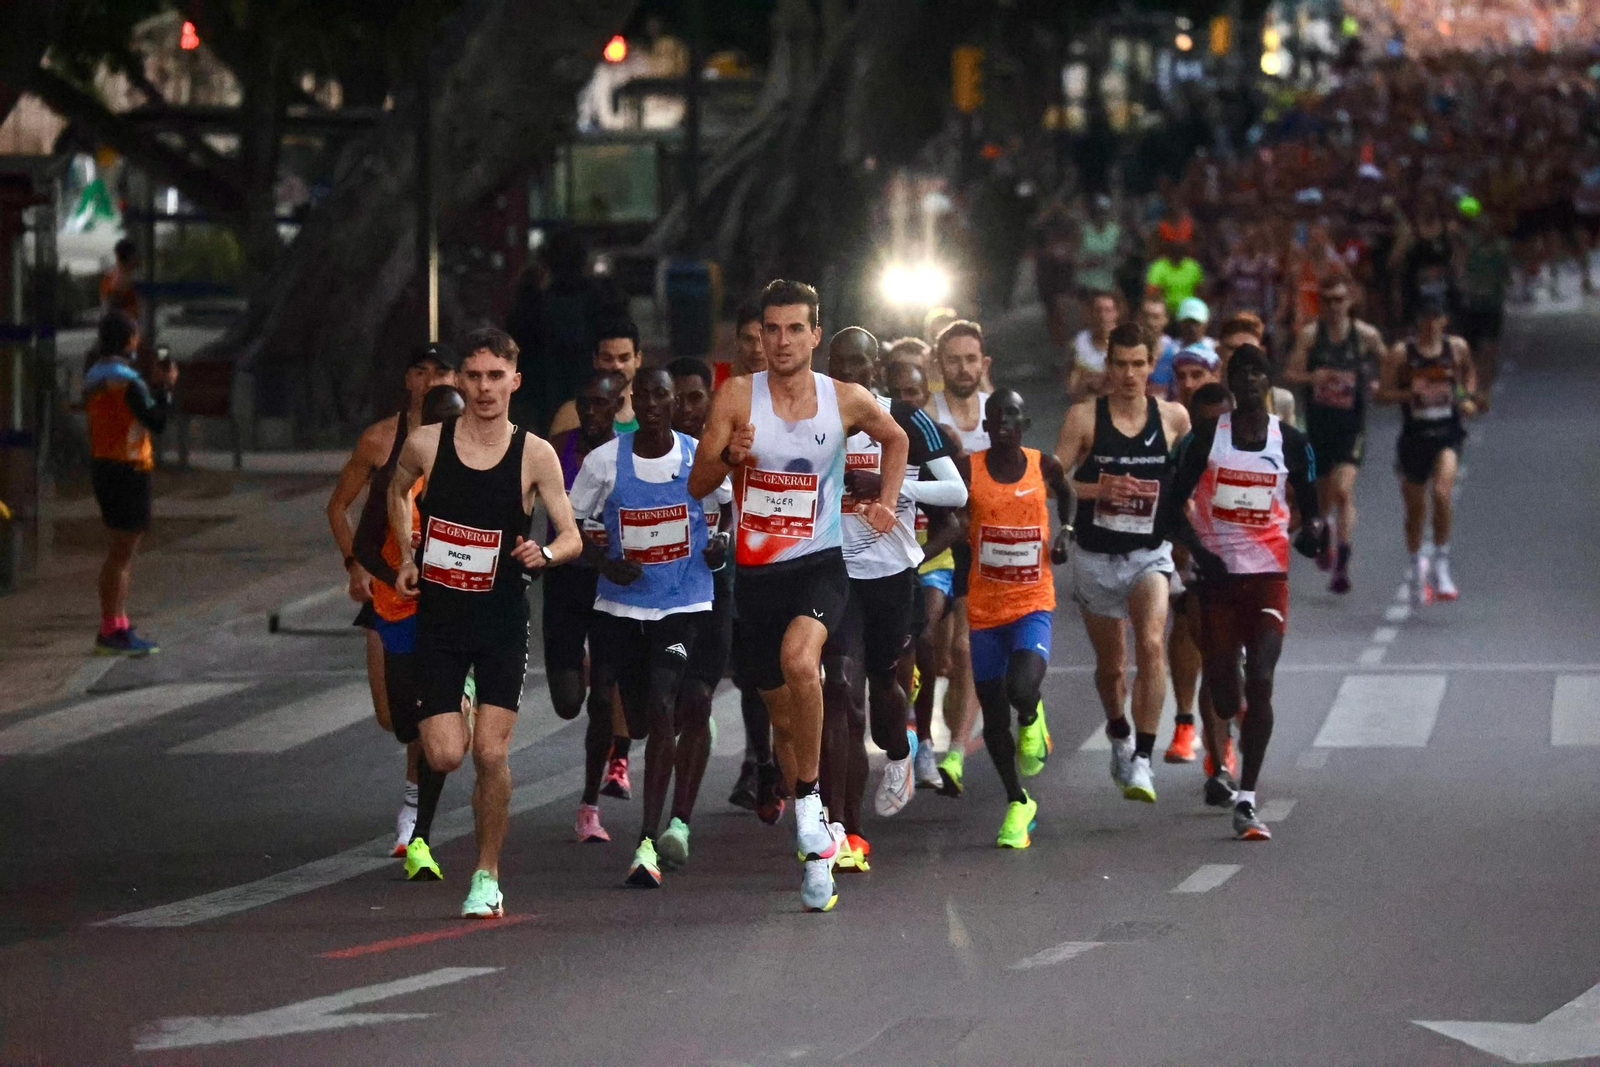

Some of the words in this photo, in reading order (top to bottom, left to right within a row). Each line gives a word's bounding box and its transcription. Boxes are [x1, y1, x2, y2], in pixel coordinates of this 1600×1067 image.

[845, 455, 875, 465] NERALI
[763, 474, 813, 487] GENERALI
[765, 496, 793, 506] PACER
[637, 508, 682, 521] GENERALI
[446, 526, 496, 544] GENERALI
[448, 550, 472, 562] PACER
